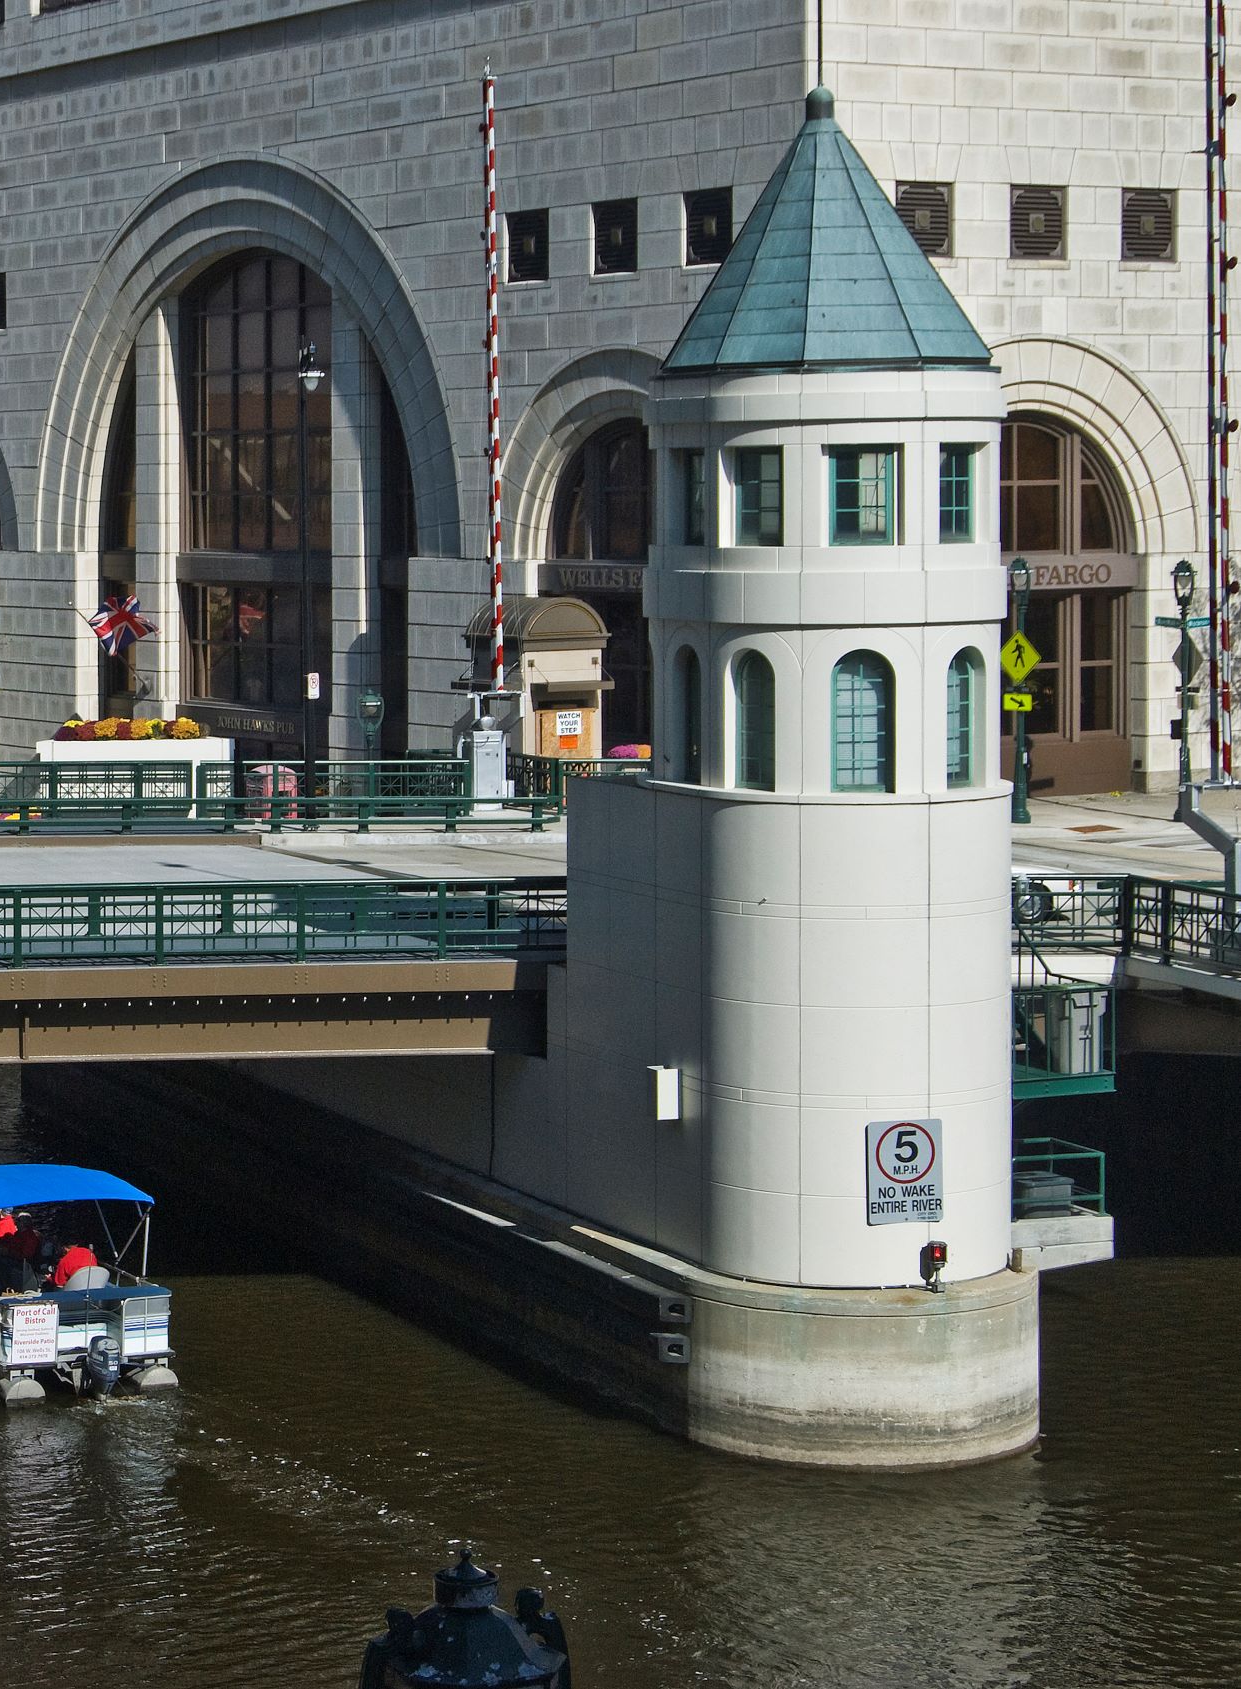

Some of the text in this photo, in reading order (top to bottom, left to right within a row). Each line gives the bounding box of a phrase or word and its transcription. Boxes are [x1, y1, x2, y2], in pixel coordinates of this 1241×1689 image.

[559, 567, 623, 589] WELLS
[1034, 563, 1112, 586] FARGO
[558, 712, 581, 720] WATCH
[217, 716, 295, 734] JOHN HAWKS PUB
[560, 719, 579, 727] YOUR
[894, 1130, 919, 1163] 5
[893, 1165, 920, 1175] M.P.H.
[878, 1184, 935, 1199] NO WAKE
[870, 1198, 942, 1214] ENTIRE RIVER
[33, 1308, 41, 1316] of
[42, 1307, 56, 1316] Call
[24, 1316, 46, 1324] Bistro
[13, 1338, 40, 1346] Riverside
